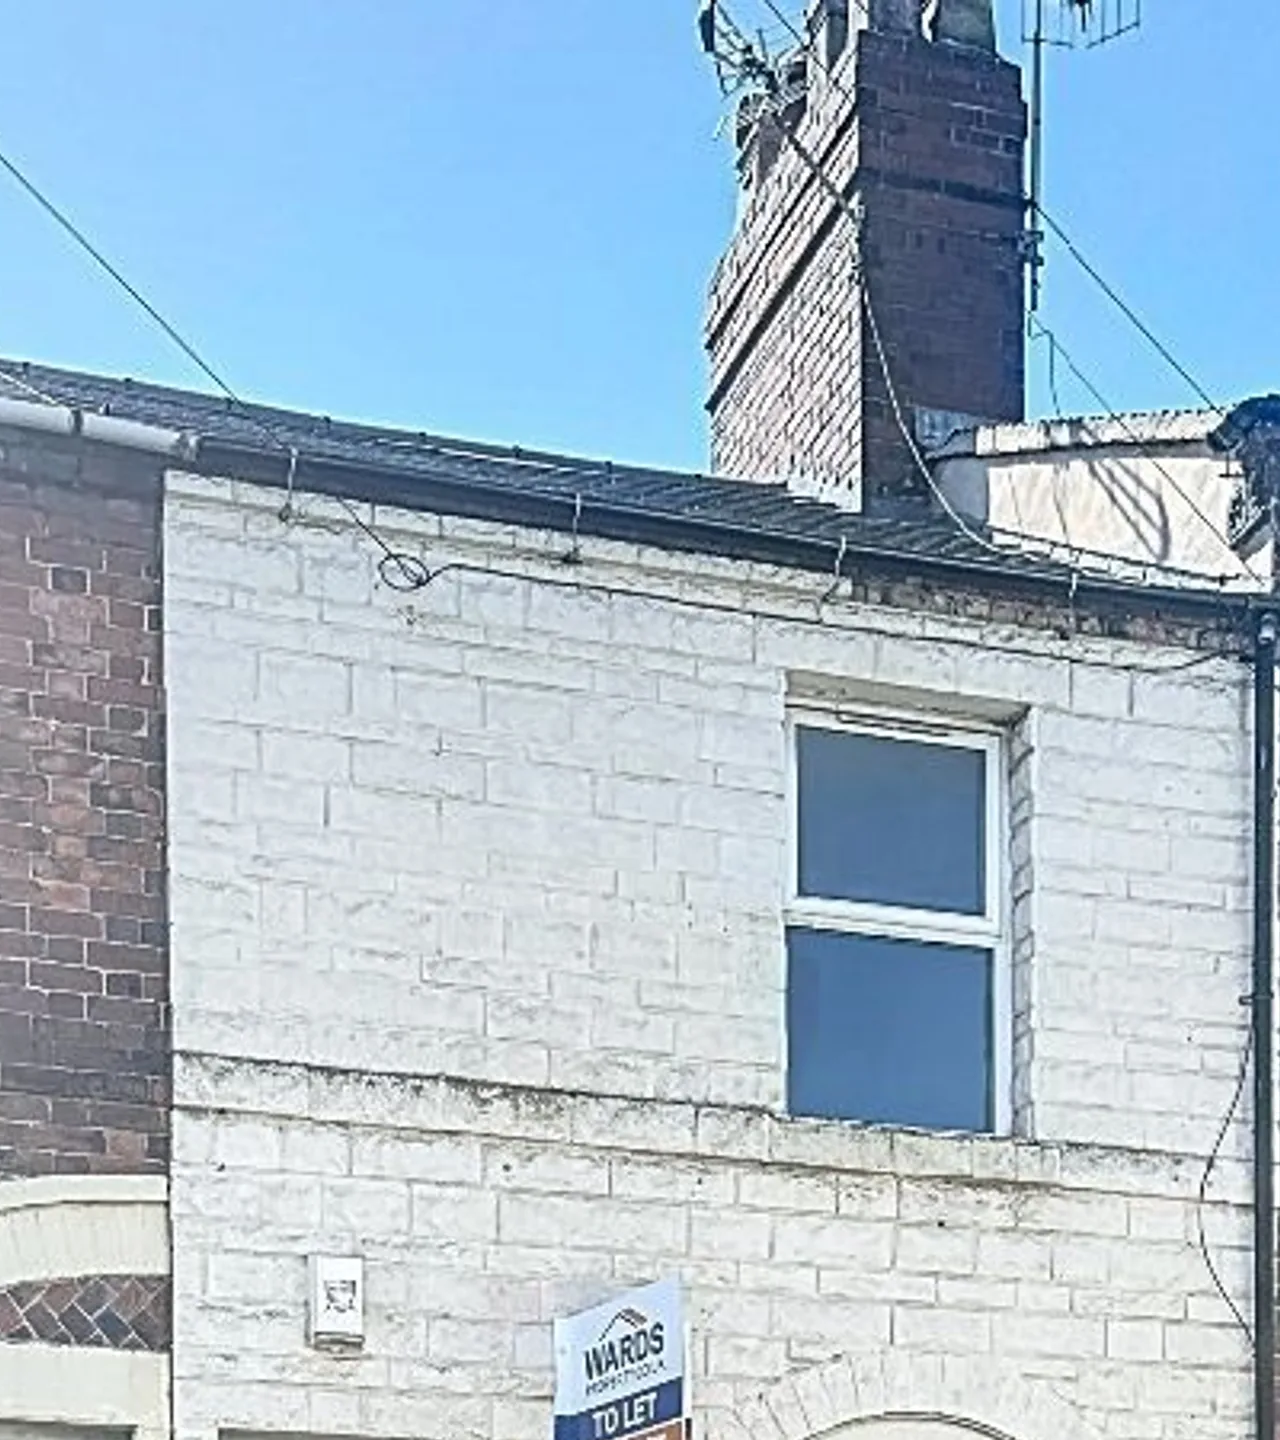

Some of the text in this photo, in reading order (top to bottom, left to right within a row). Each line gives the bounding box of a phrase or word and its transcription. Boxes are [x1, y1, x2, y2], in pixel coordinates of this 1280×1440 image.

[584, 1321, 664, 1380] WARDS
[592, 1391, 658, 1439] TO LET
